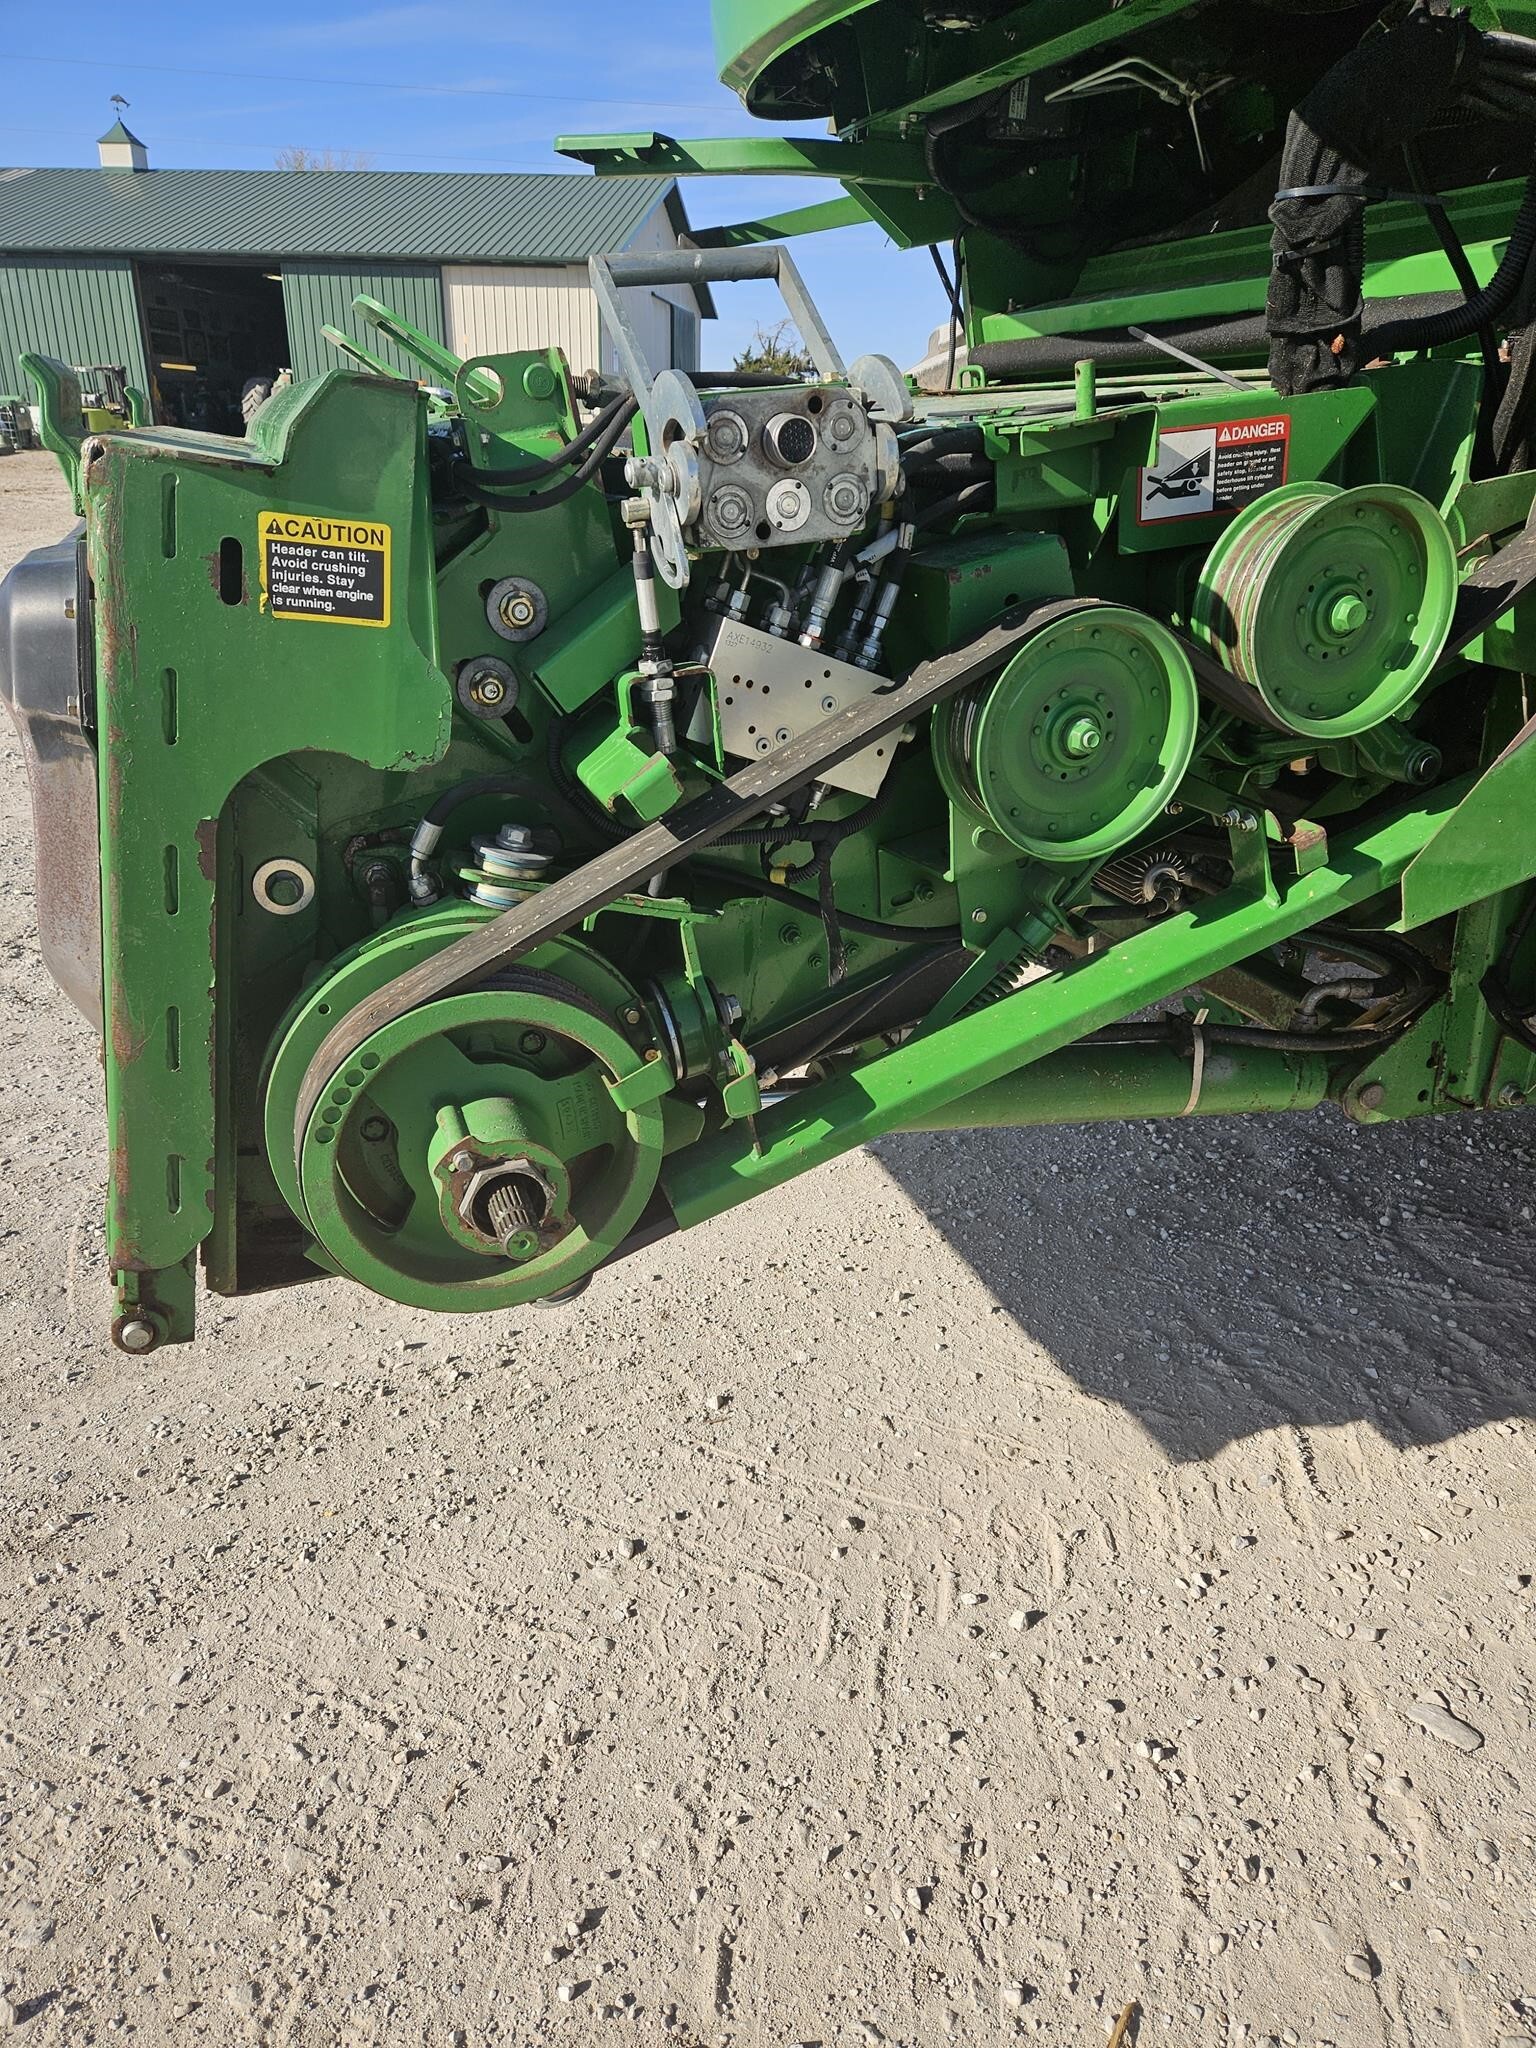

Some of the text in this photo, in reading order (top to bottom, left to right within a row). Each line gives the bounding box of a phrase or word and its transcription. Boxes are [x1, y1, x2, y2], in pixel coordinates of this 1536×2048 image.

[1232, 422, 1284, 440] DANGER
[1244, 458, 1261, 466] grnd
[1254, 473, 1273, 481] cylinder
[284, 519, 384, 546] CAUTION
[271, 543, 370, 563] Header can tilt.
[271, 556, 366, 577] Avoid crushing
[271, 569, 355, 589] injuries. Stay
[272, 582, 374, 602] clear when engine
[272, 595, 336, 612] is running.
[726, 631, 774, 654] AXE14932
